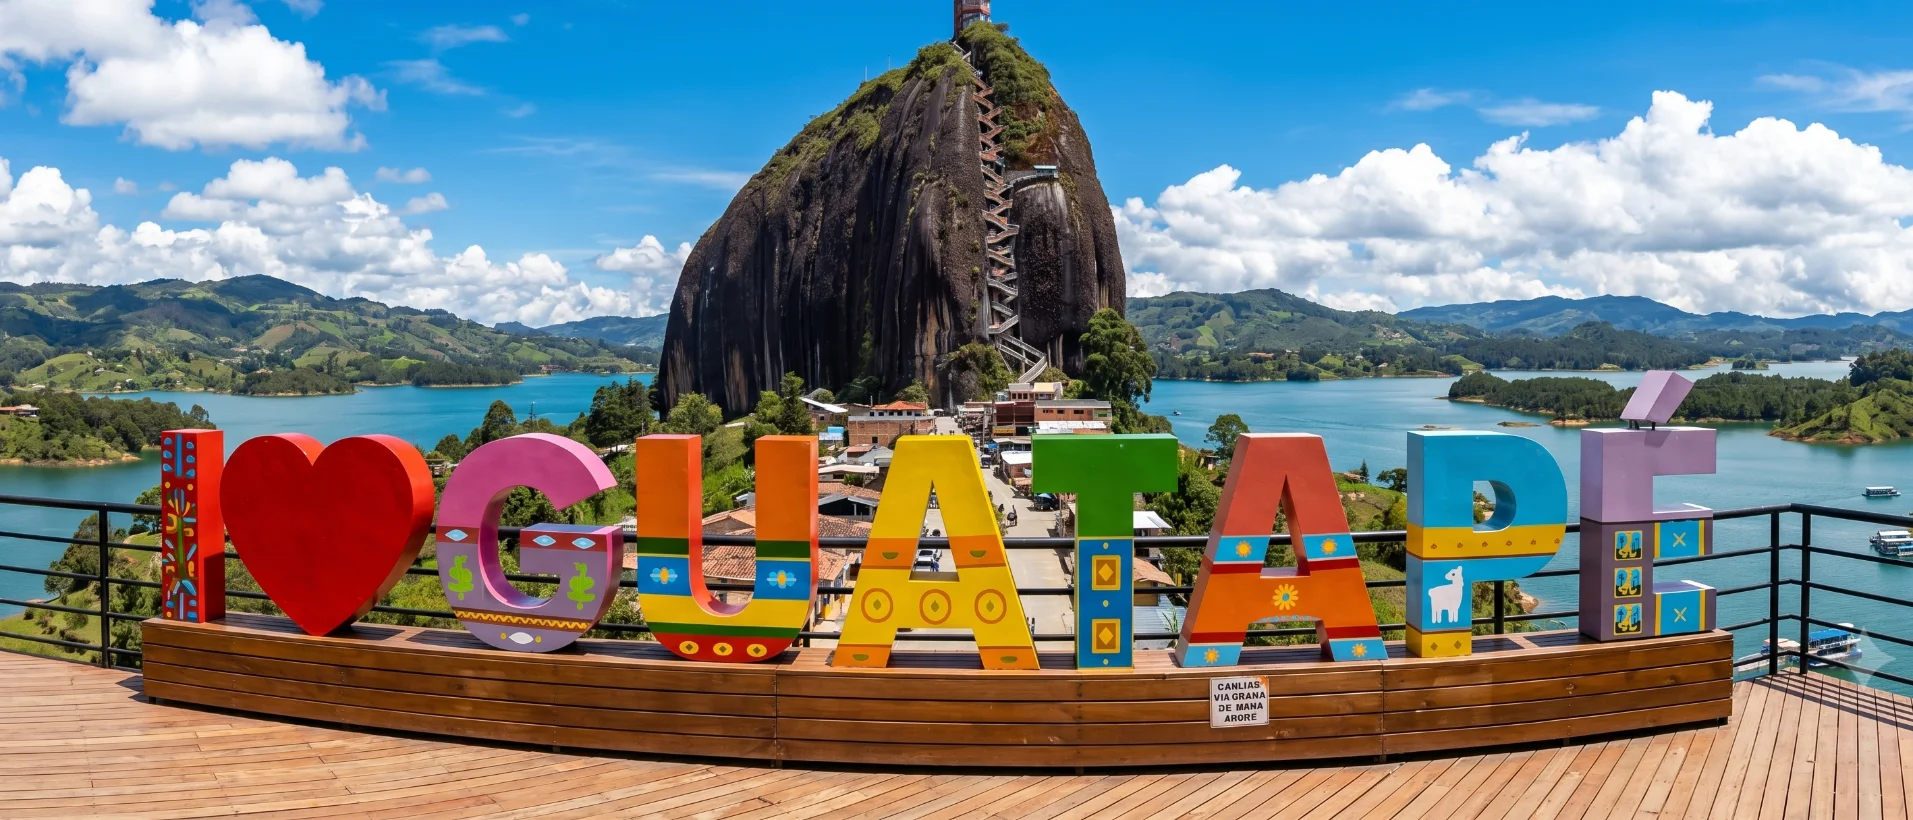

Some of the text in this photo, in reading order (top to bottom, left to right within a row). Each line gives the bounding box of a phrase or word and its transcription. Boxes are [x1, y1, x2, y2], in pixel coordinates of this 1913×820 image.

[161, 370, 1717, 670] I GUATAPÉ
[1217, 681, 1260, 691] CANLIAS
[1213, 691, 1266, 702] VIA GRANA
[1218, 702, 1264, 712] DE MANA
[1224, 713, 1257, 723] ARORE
